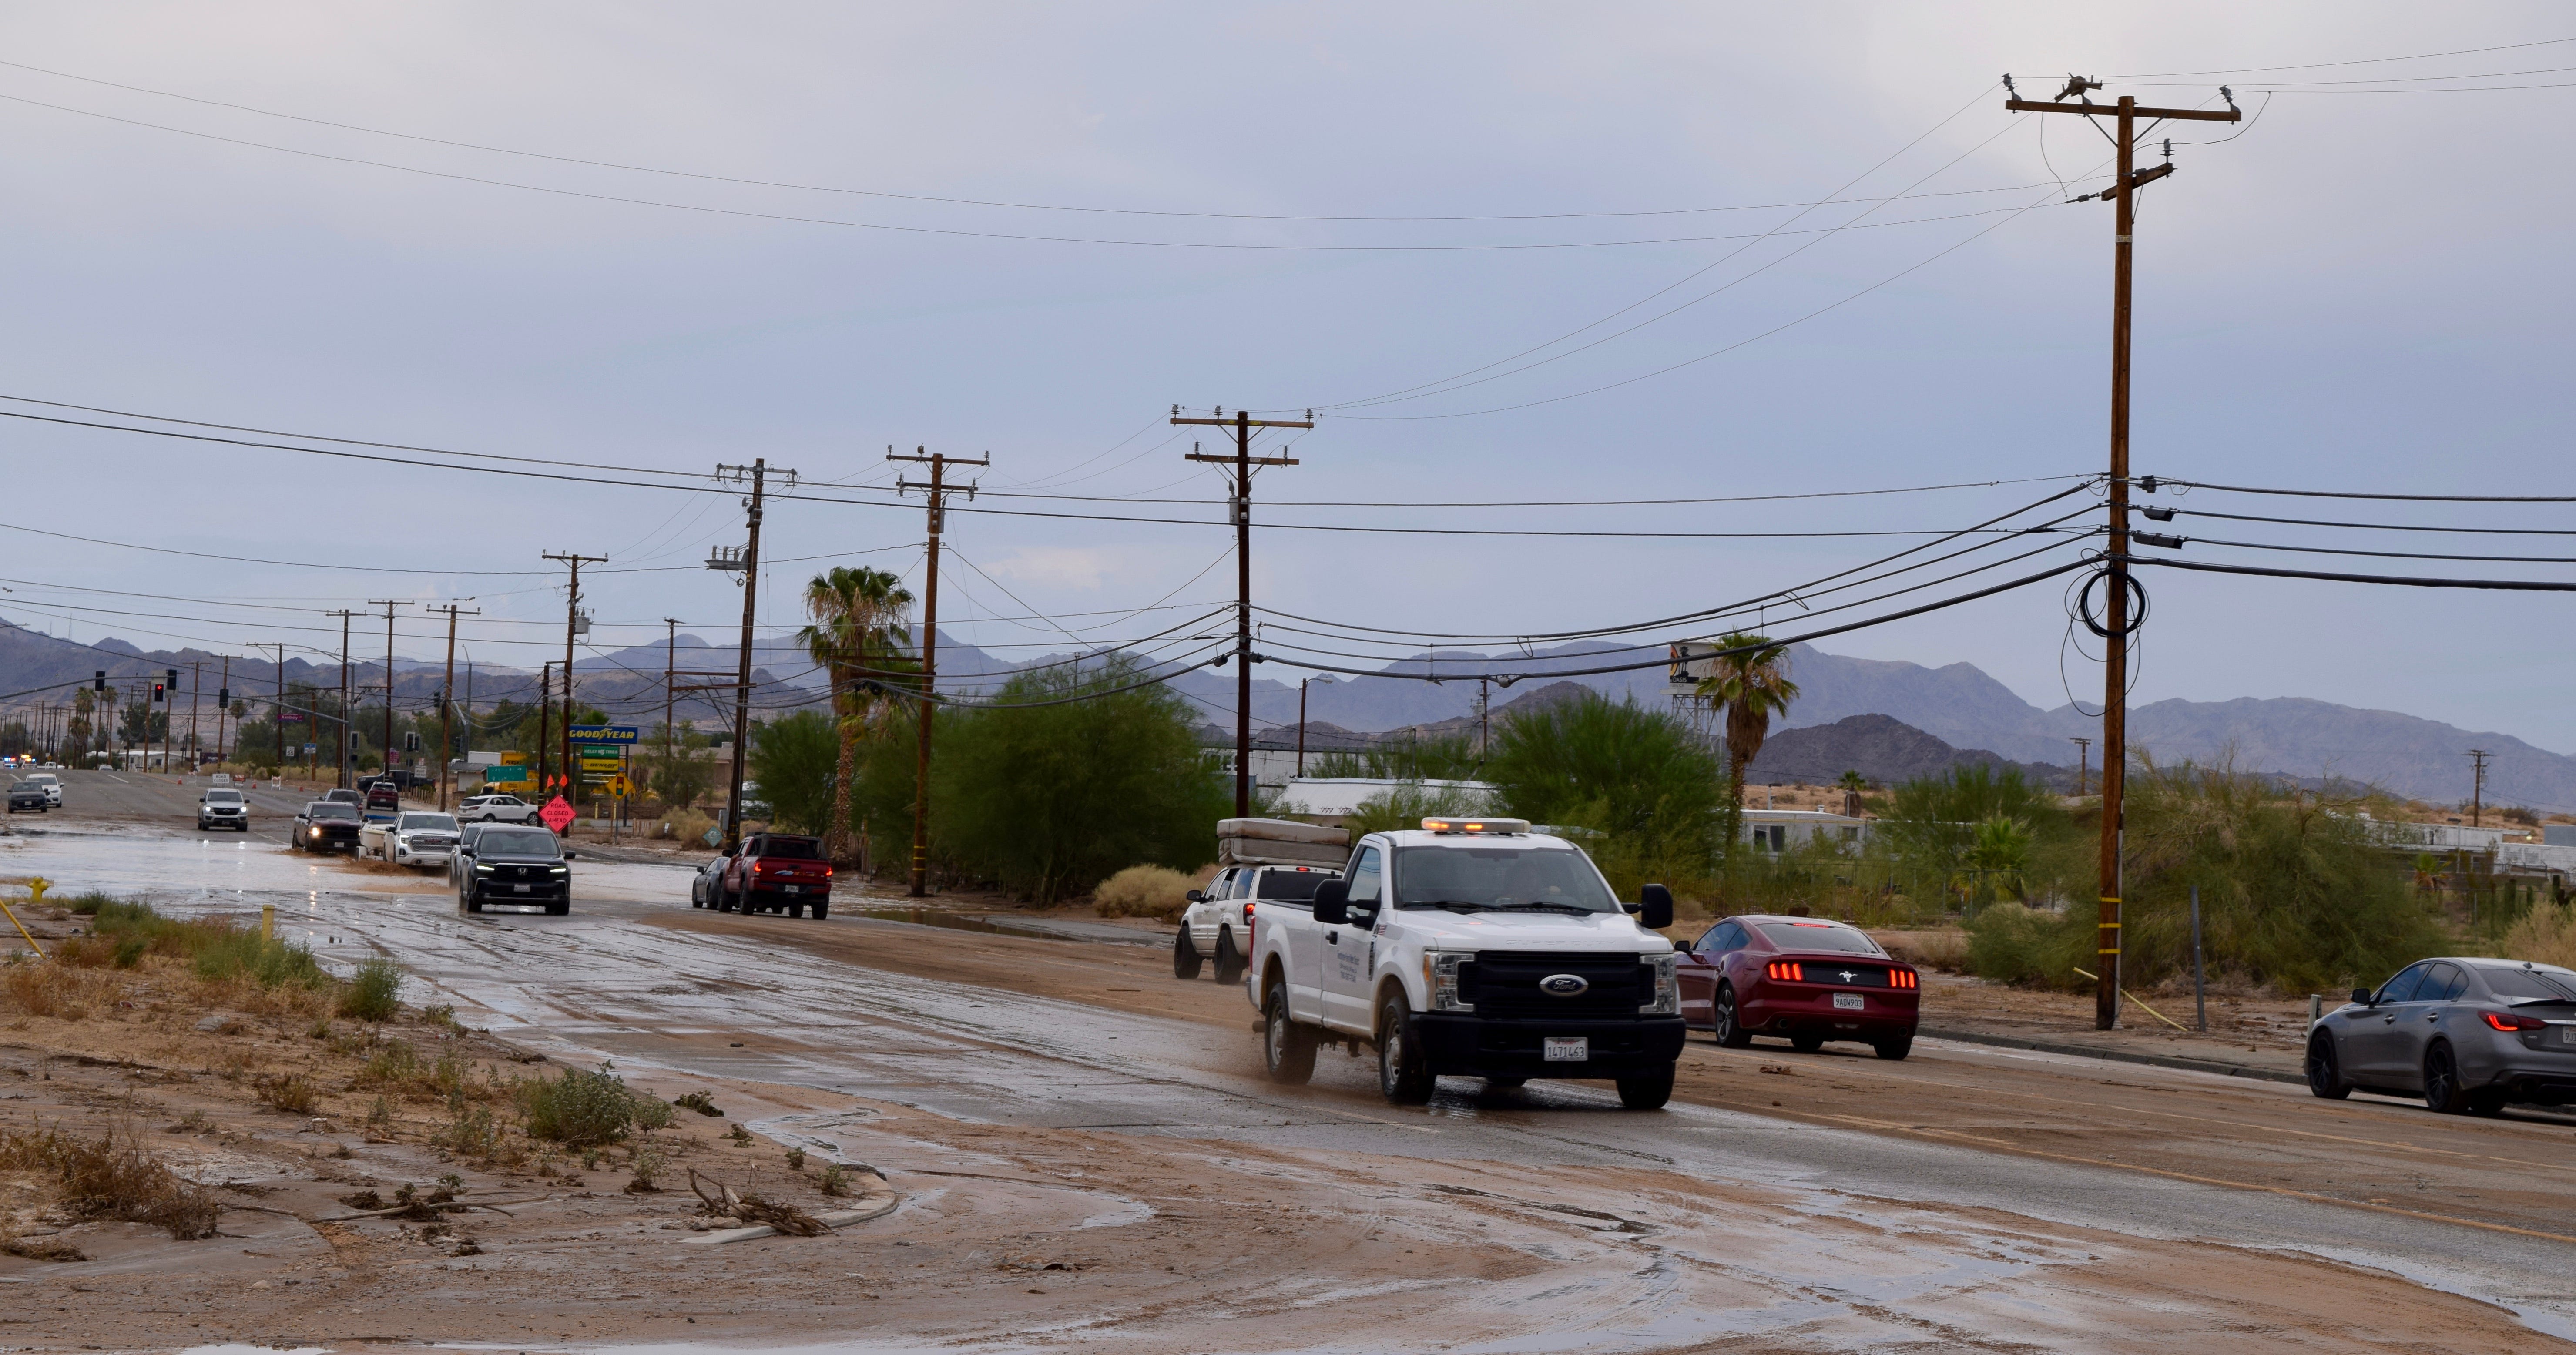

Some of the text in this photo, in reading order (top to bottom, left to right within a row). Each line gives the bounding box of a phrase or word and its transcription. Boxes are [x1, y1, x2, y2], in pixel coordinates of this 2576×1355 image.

[569, 728, 635, 740] GOODYEAR
[1553, 979, 1576, 990] Ford
[1547, 1046, 1584, 1057] 1471463
